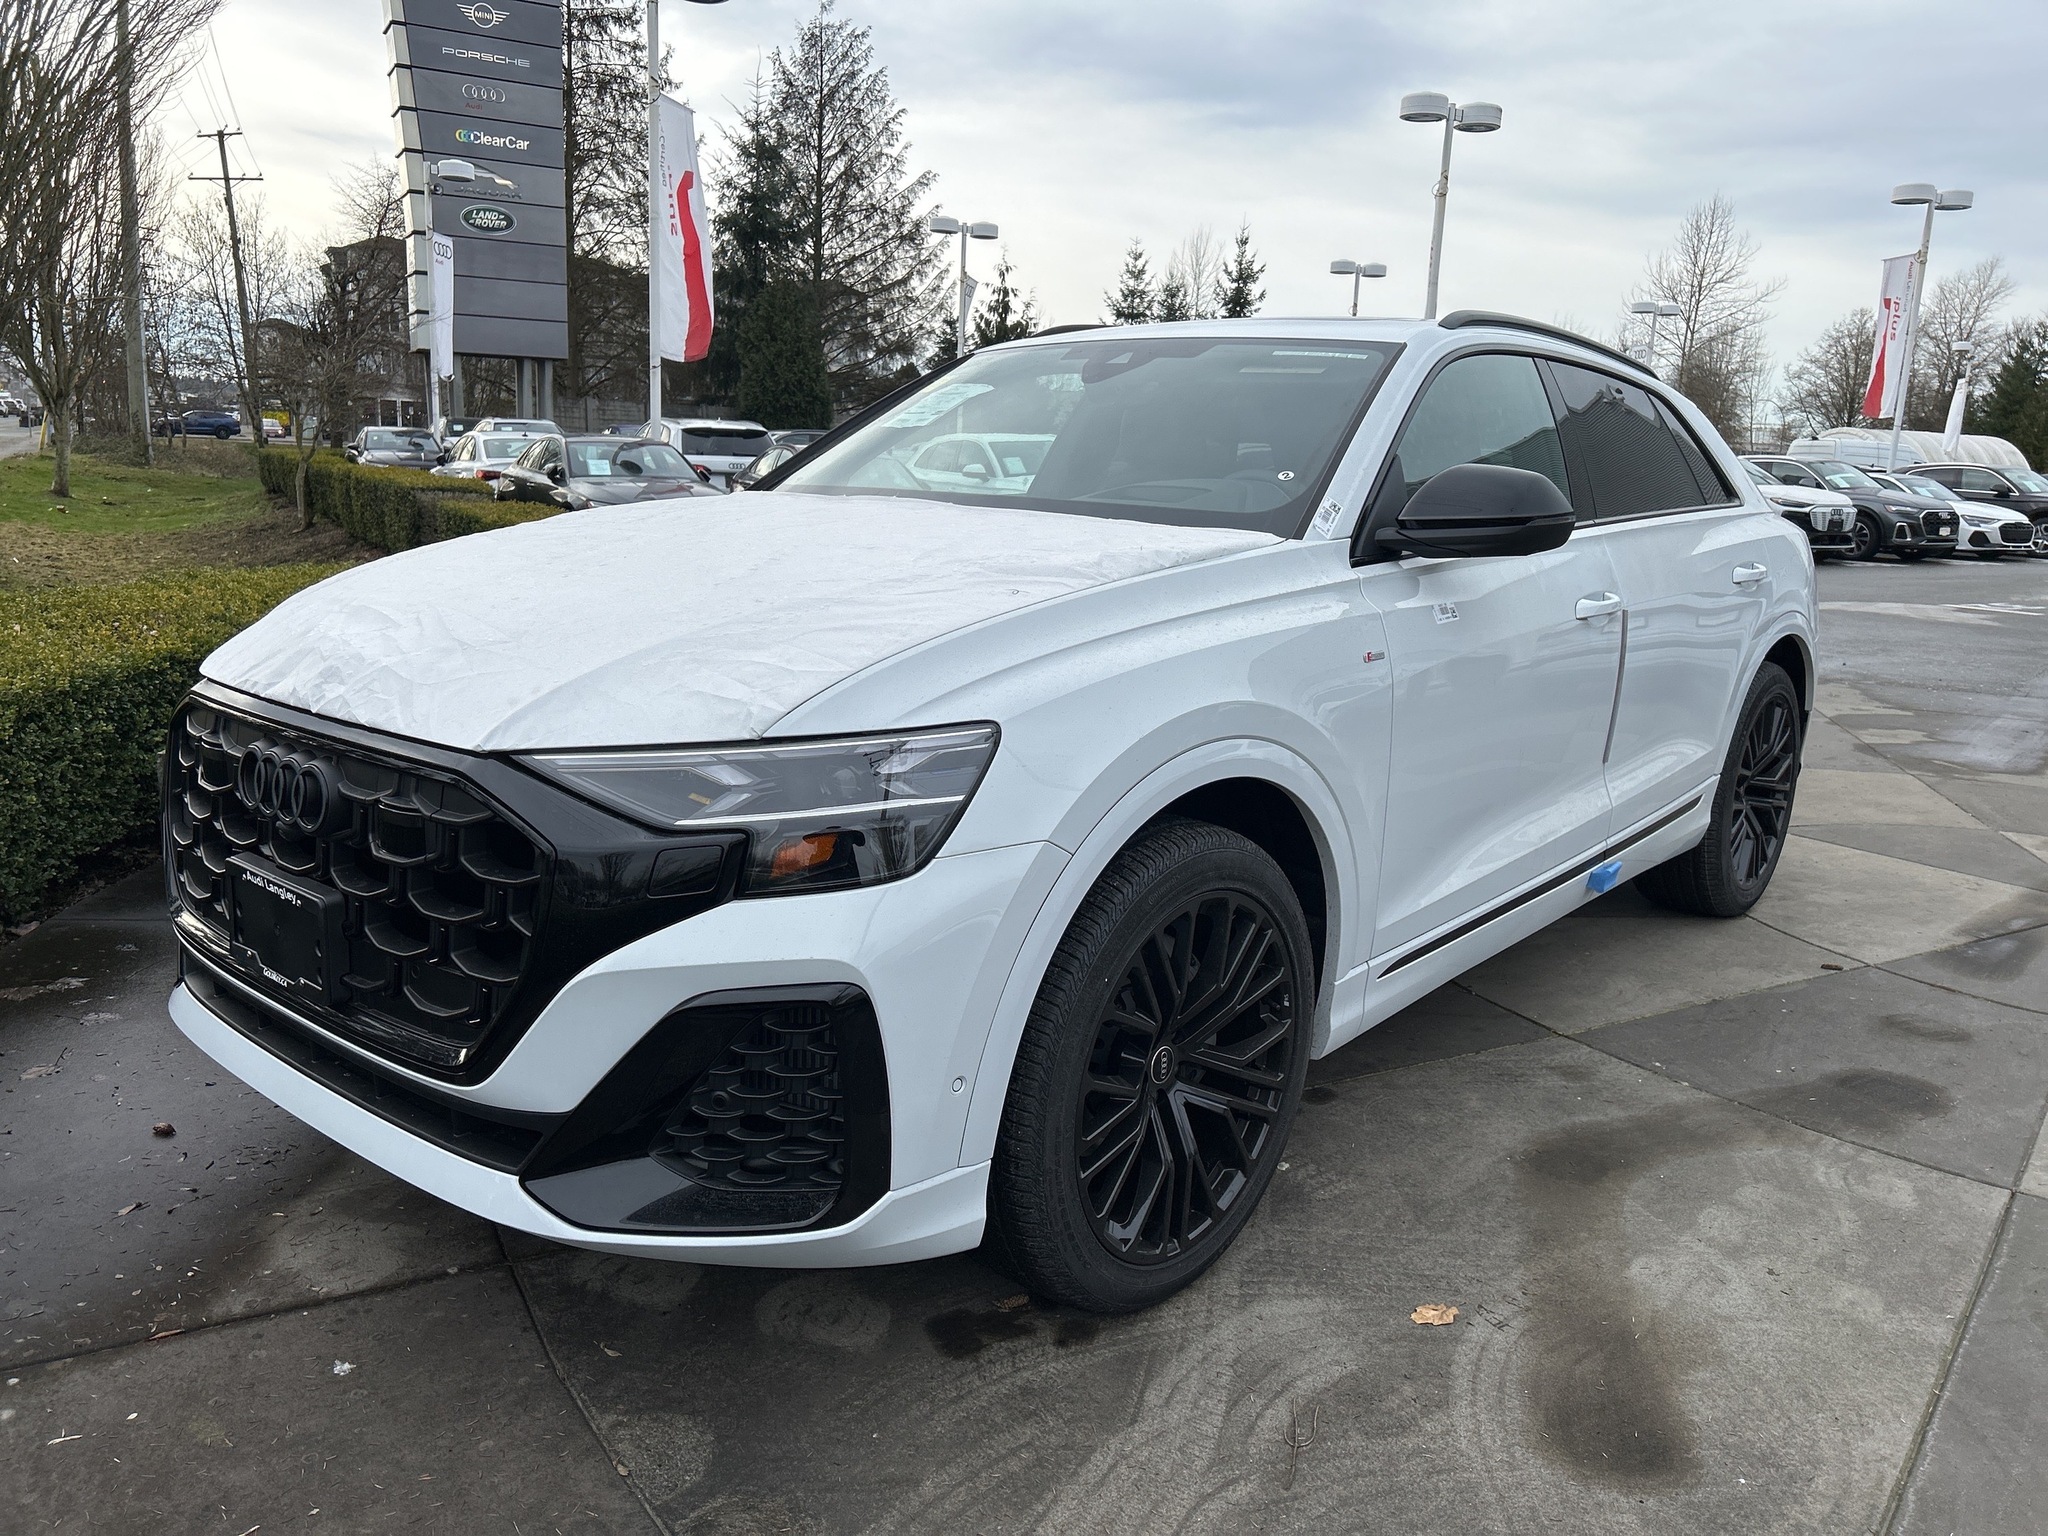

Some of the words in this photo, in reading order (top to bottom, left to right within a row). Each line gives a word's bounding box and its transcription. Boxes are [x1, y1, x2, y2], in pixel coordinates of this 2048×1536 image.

[474, 10, 494, 20] MINI
[442, 47, 531, 68] PORSCHE
[464, 102, 483, 111] Audi
[469, 131, 530, 151] ClearCar
[471, 210, 499, 220] LAND
[474, 218, 508, 229] ROVER
[246, 870, 264, 888] Audi
[264, 878, 297, 905] Langley
